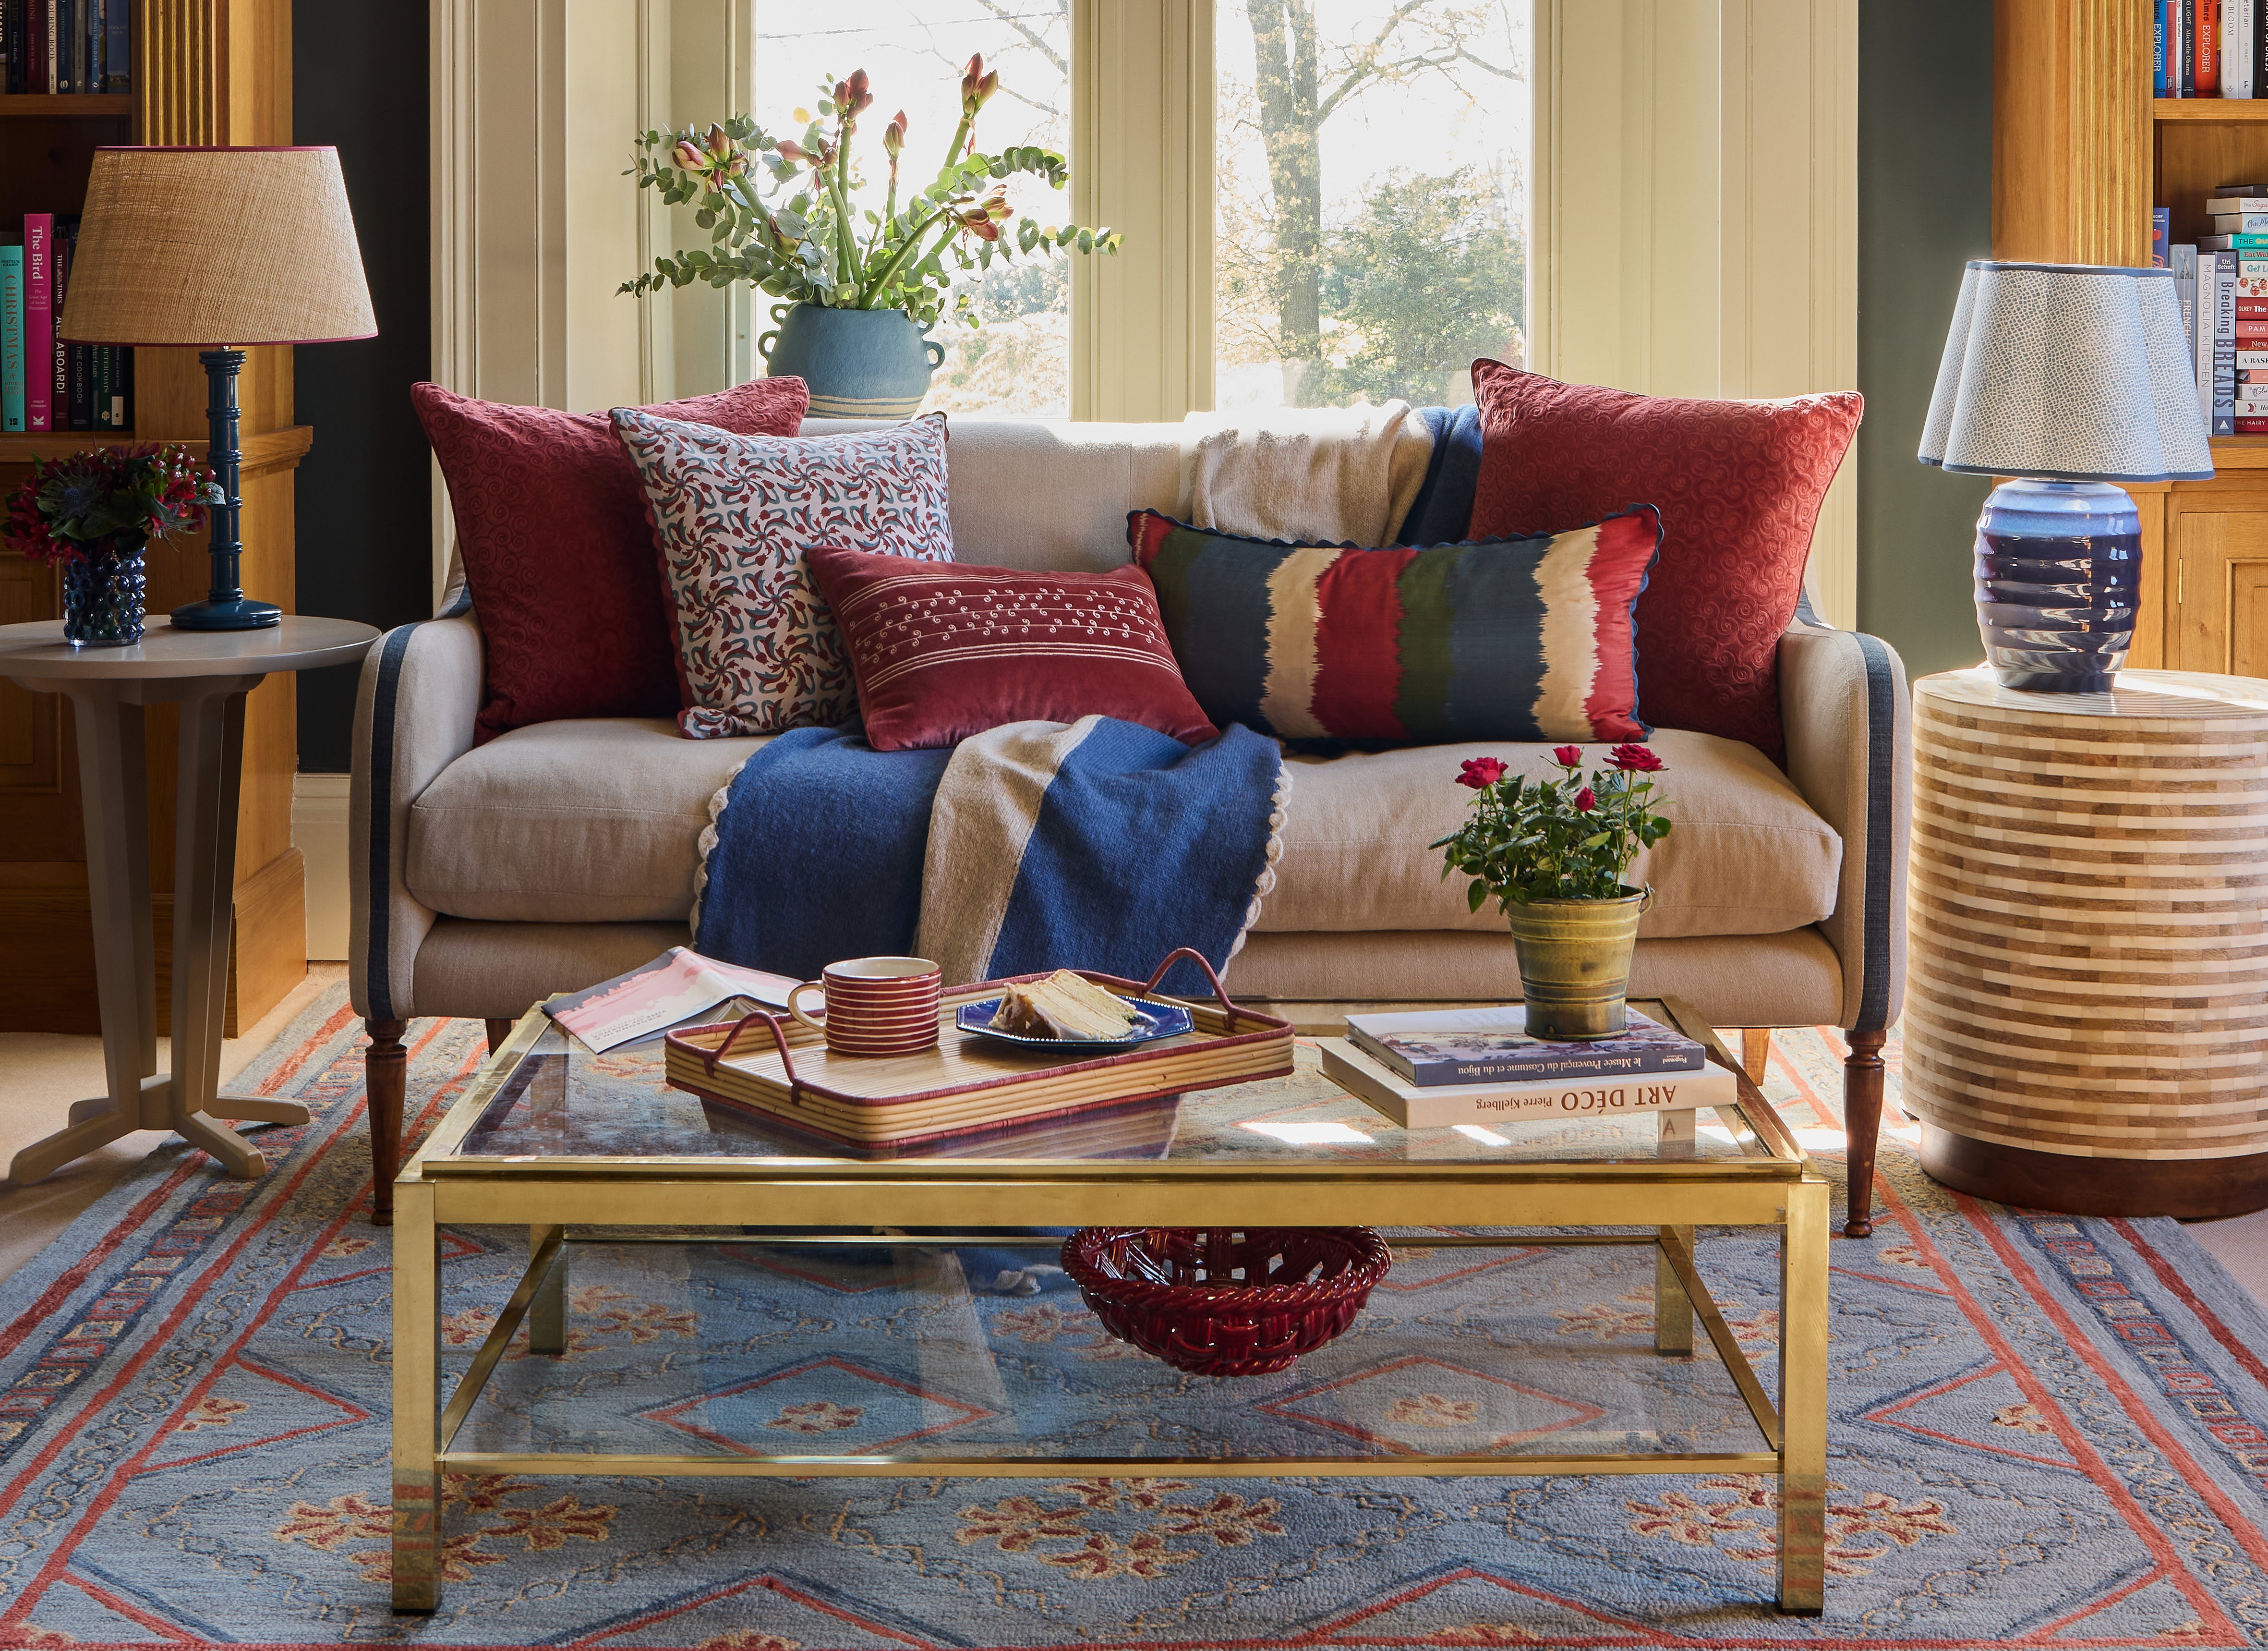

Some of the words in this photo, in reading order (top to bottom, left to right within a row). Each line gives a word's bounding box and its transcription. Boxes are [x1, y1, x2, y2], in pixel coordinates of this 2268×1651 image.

[2202, 25, 2210, 73] EXPLORER
[32, 226, 42, 250] The
[33, 253, 43, 279] Bird
[2202, 265, 2211, 329] MAGNOLIA
[2218, 282, 2234, 334] Breaking
[5, 275, 19, 369] CHRISTMAS
[2183, 300, 2192, 336] FRENCH
[56, 342, 65, 394] ABOARD!
[2201, 335, 2211, 387] KITCHEN
[2214, 339, 2234, 408] BREADS
[1458, 1065, 1480, 1076] Bijou
[1483, 1066, 1494, 1075] du
[1508, 1063, 1544, 1073] Costume
[1547, 1062, 1558, 1072] du
[1561, 1059, 1601, 1071] Provençal
[1604, 1058, 1631, 1068] Musée
[1634, 1057, 1641, 1067] le
[1476, 1098, 1520, 1111] Kjellberg
[1523, 1097, 1552, 1108] Pierre
[1561, 1089, 1624, 1114] DÉCO
[1634, 1086, 1677, 1105] ART
